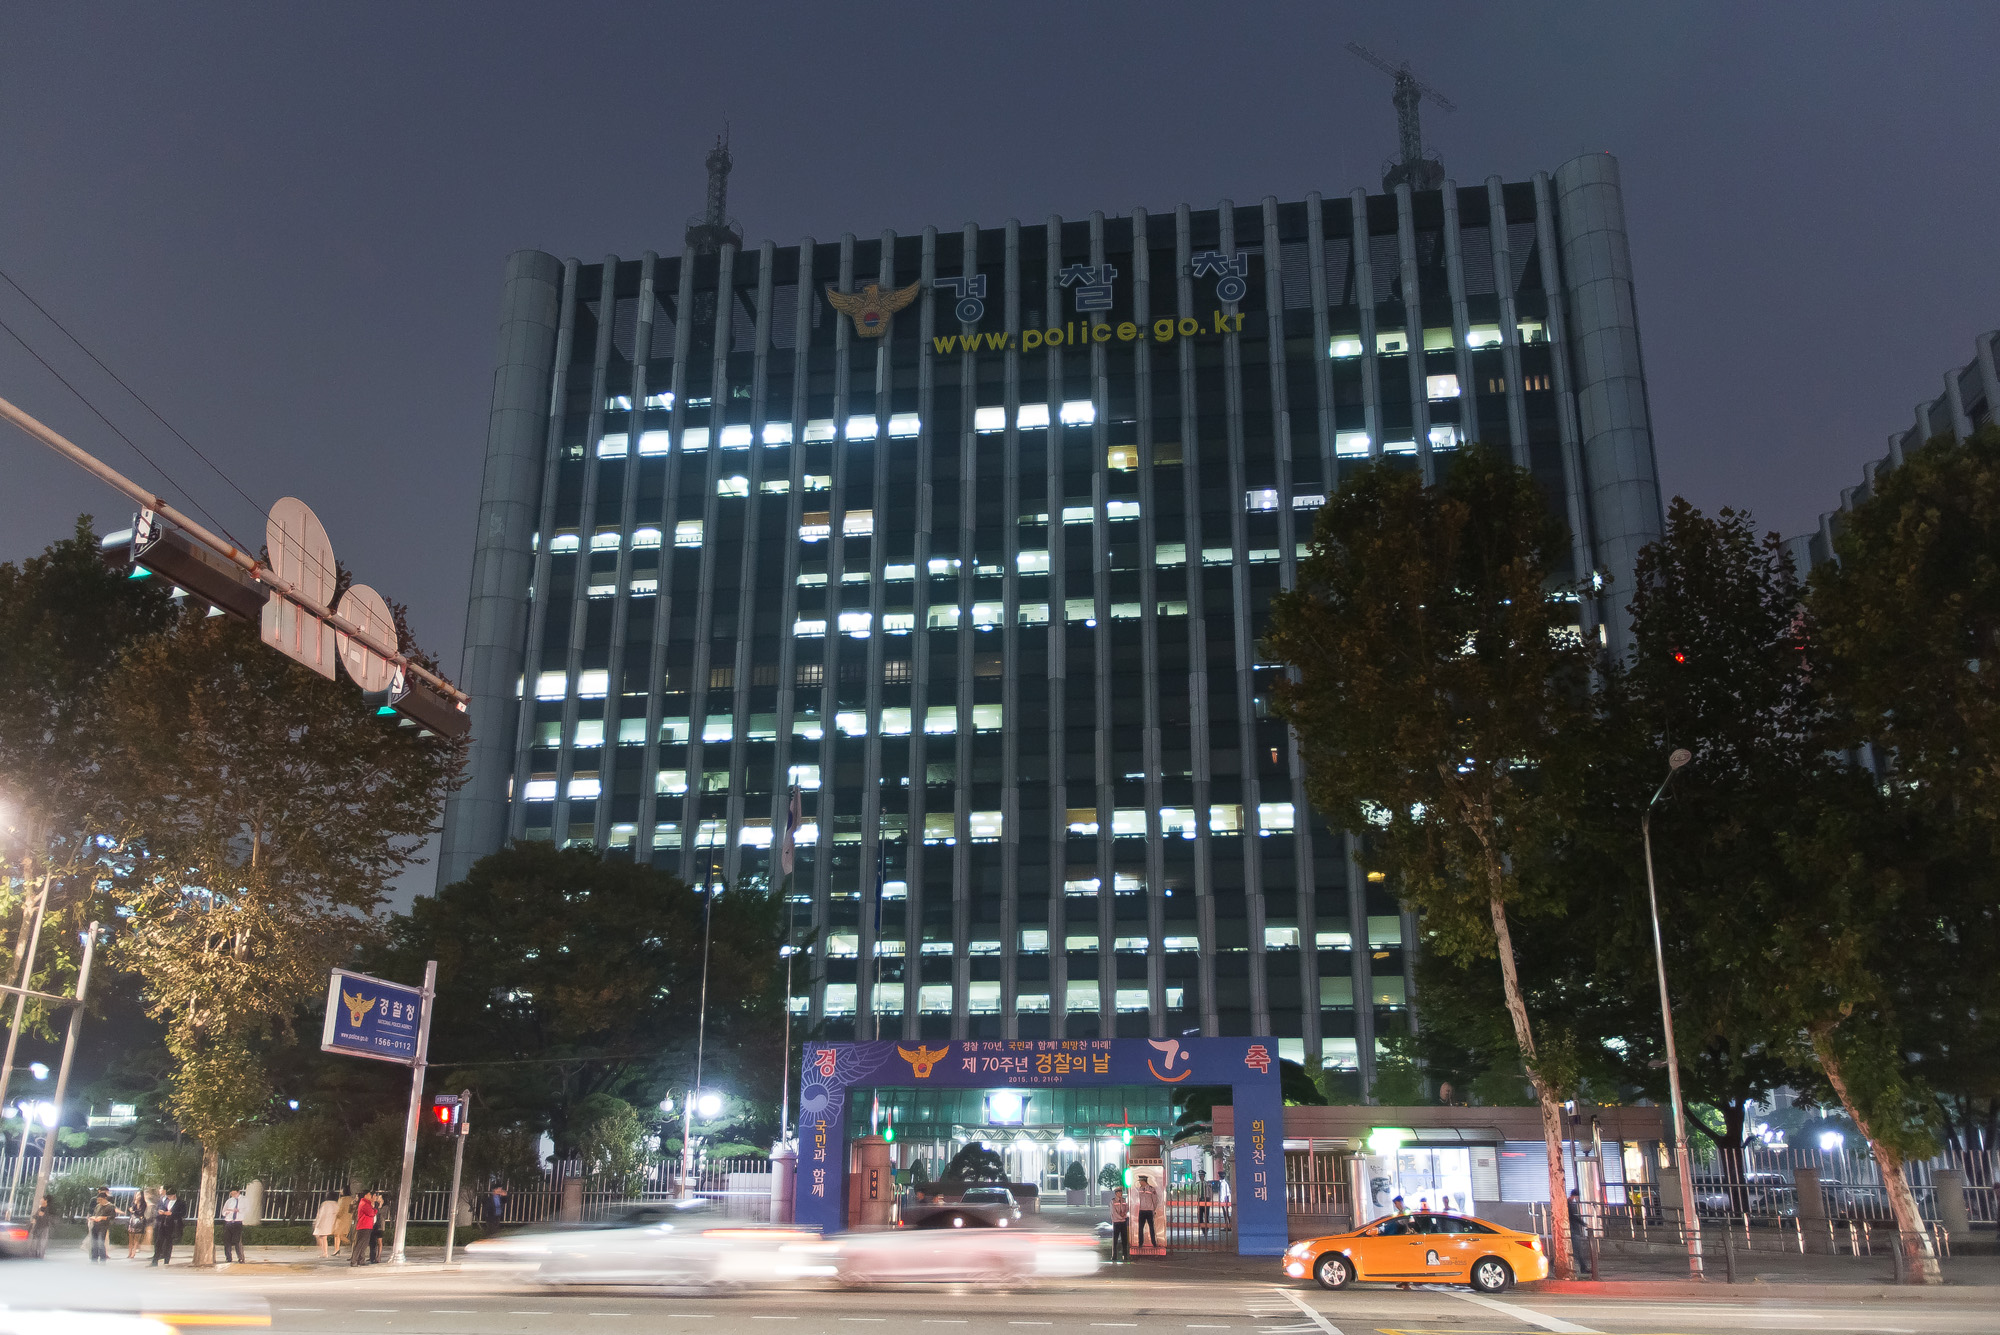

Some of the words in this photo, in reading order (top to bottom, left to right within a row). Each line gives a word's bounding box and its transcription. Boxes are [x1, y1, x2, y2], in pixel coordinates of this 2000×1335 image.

[933, 310, 1246, 354] www.police.go.kr
[379, 998, 415, 1022] 경찰청
[374, 1036, 411, 1051] 1566-0112
[962, 1041, 979, 1052] 경찰
[1008, 1041, 1033, 1051] 국민과
[1038, 1040, 1058, 1051] 함께!
[1061, 1040, 1087, 1051] 희망찬
[1091, 1040, 1112, 1050] 미래!
[814, 1048, 837, 1078] 경
[962, 1056, 977, 1073] 제
[981, 1056, 1028, 1073] 70주년
[1035, 1052, 1087, 1074] 경찰의
[1092, 1052, 1112, 1074] 날
[1244, 1044, 1272, 1074] 축
[812, 1119, 827, 1163] 국민과
[1251, 1119, 1267, 1164] 희망찬
[811, 1168, 826, 1198] 함께
[1253, 1171, 1269, 1202] 미래
